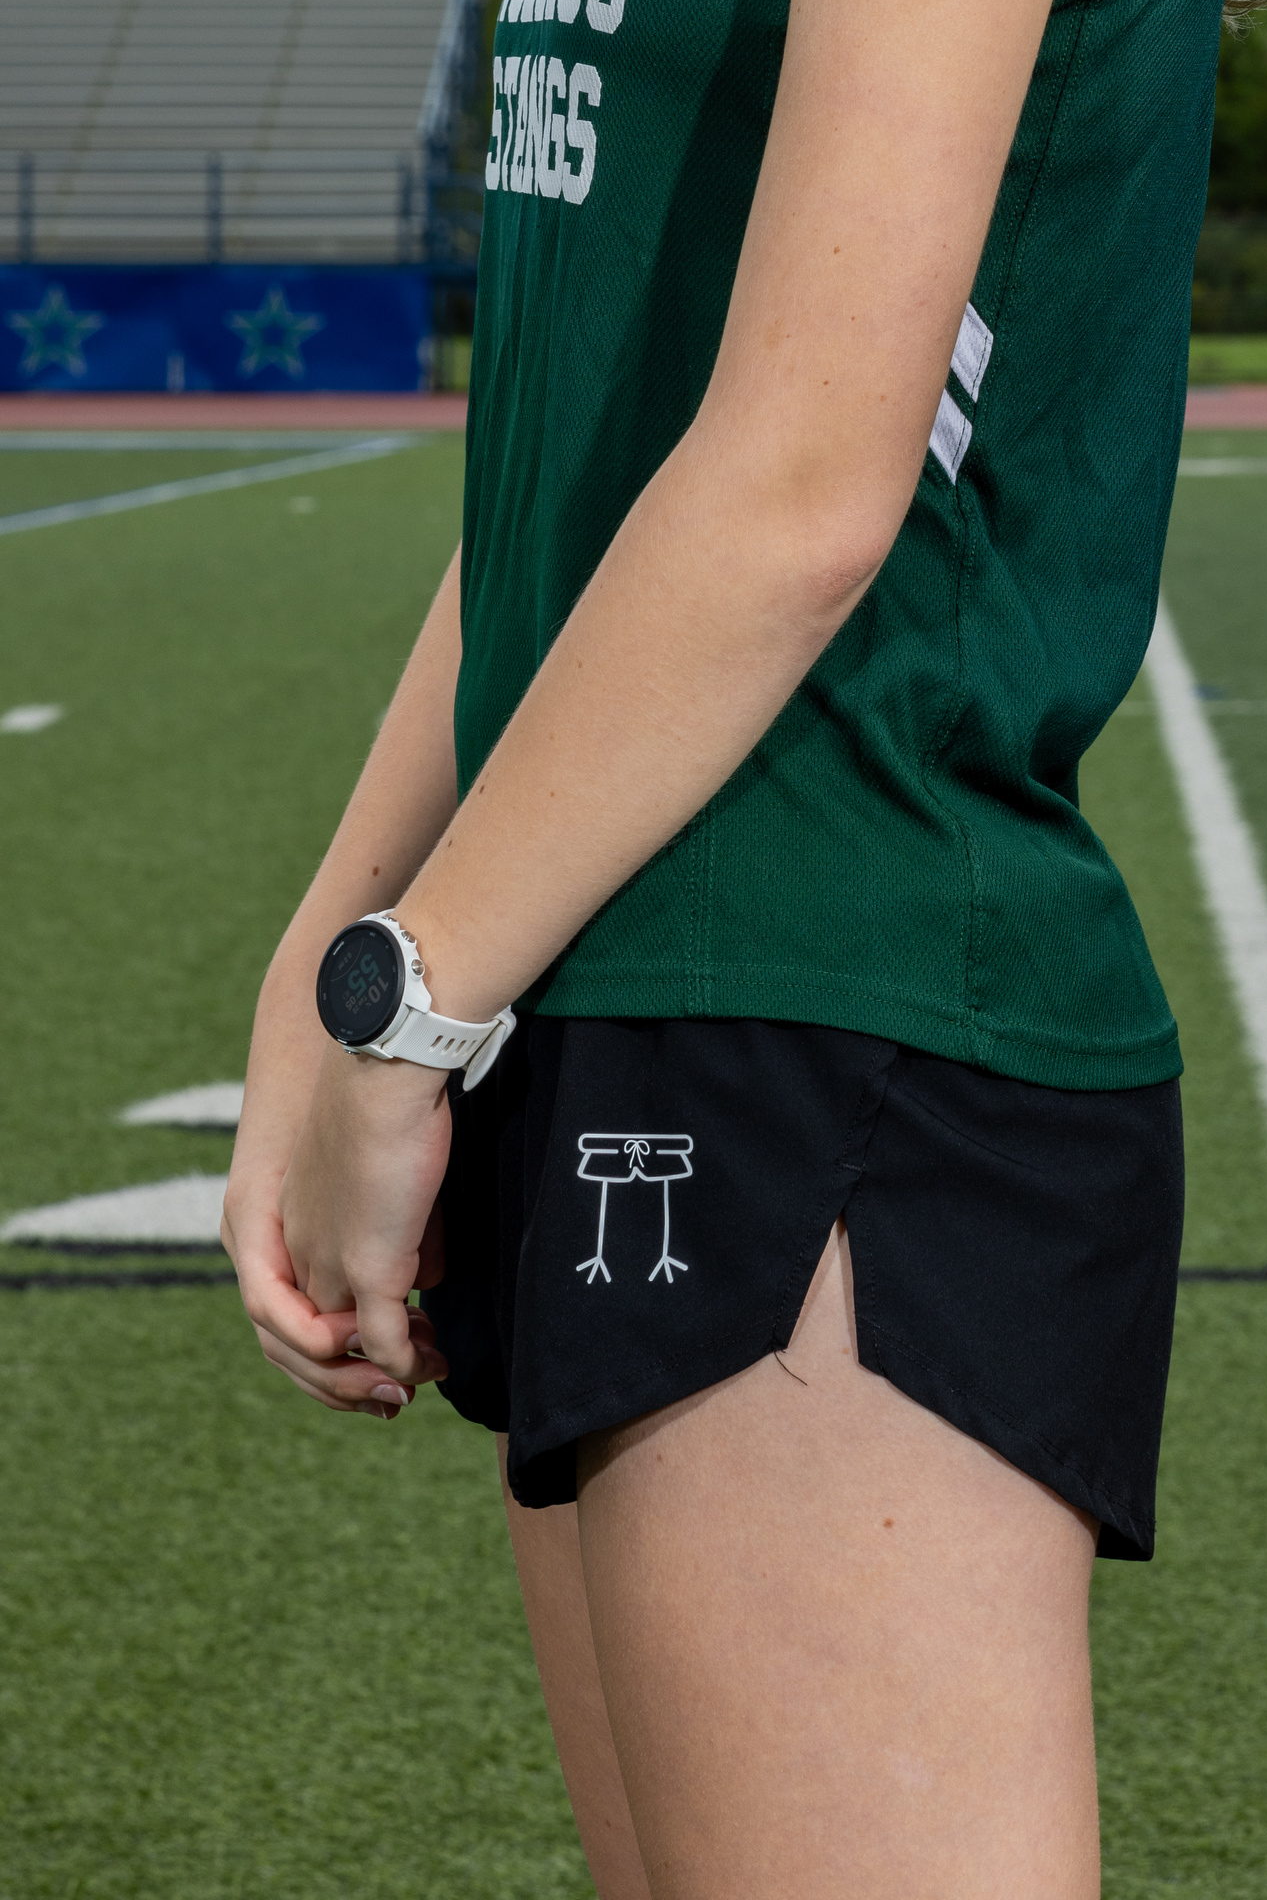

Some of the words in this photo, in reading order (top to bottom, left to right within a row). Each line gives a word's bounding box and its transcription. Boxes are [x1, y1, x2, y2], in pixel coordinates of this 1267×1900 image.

[486, 55, 602, 205] STANGS
[348, 953, 380, 998] 55
[368, 975, 389, 1003] 10
